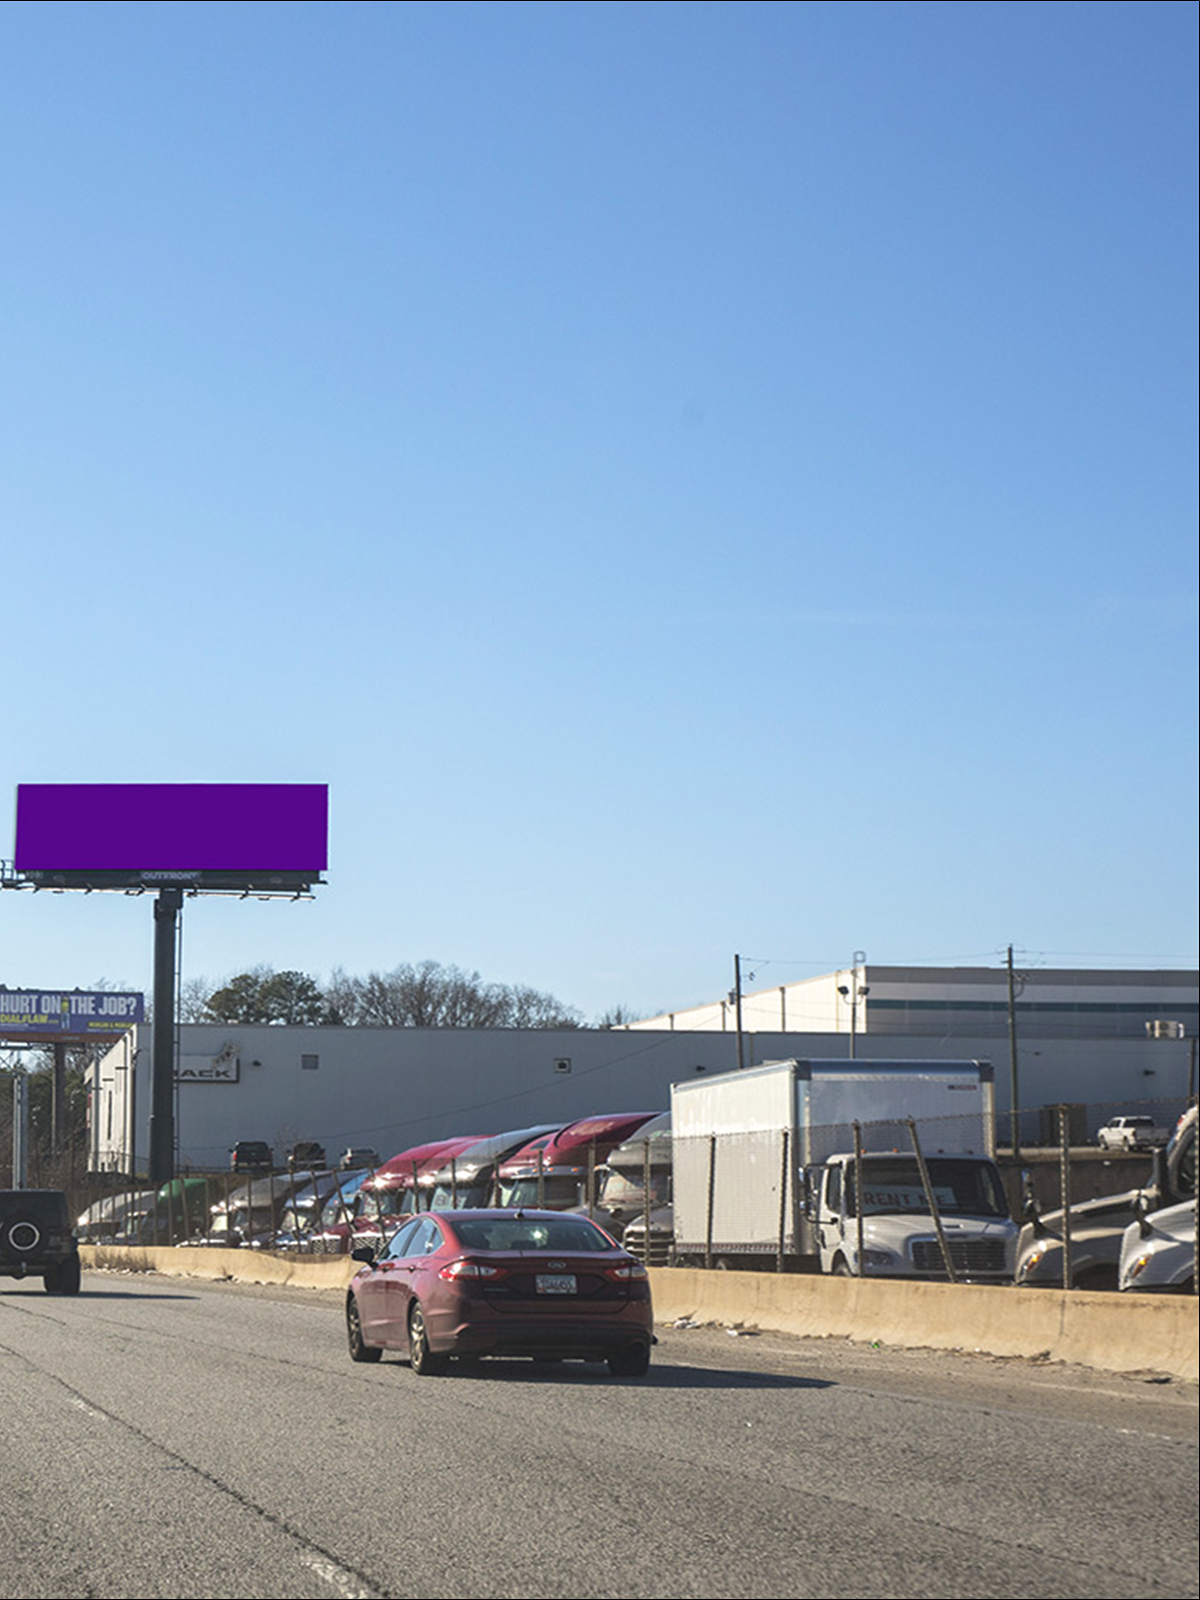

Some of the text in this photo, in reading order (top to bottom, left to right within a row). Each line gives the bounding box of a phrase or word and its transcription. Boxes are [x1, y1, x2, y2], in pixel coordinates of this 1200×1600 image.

[0, 994, 137, 1016] HURT ON THE JOB?
[174, 1069, 231, 1078] ACK
[863, 1192, 911, 1206] RENT
